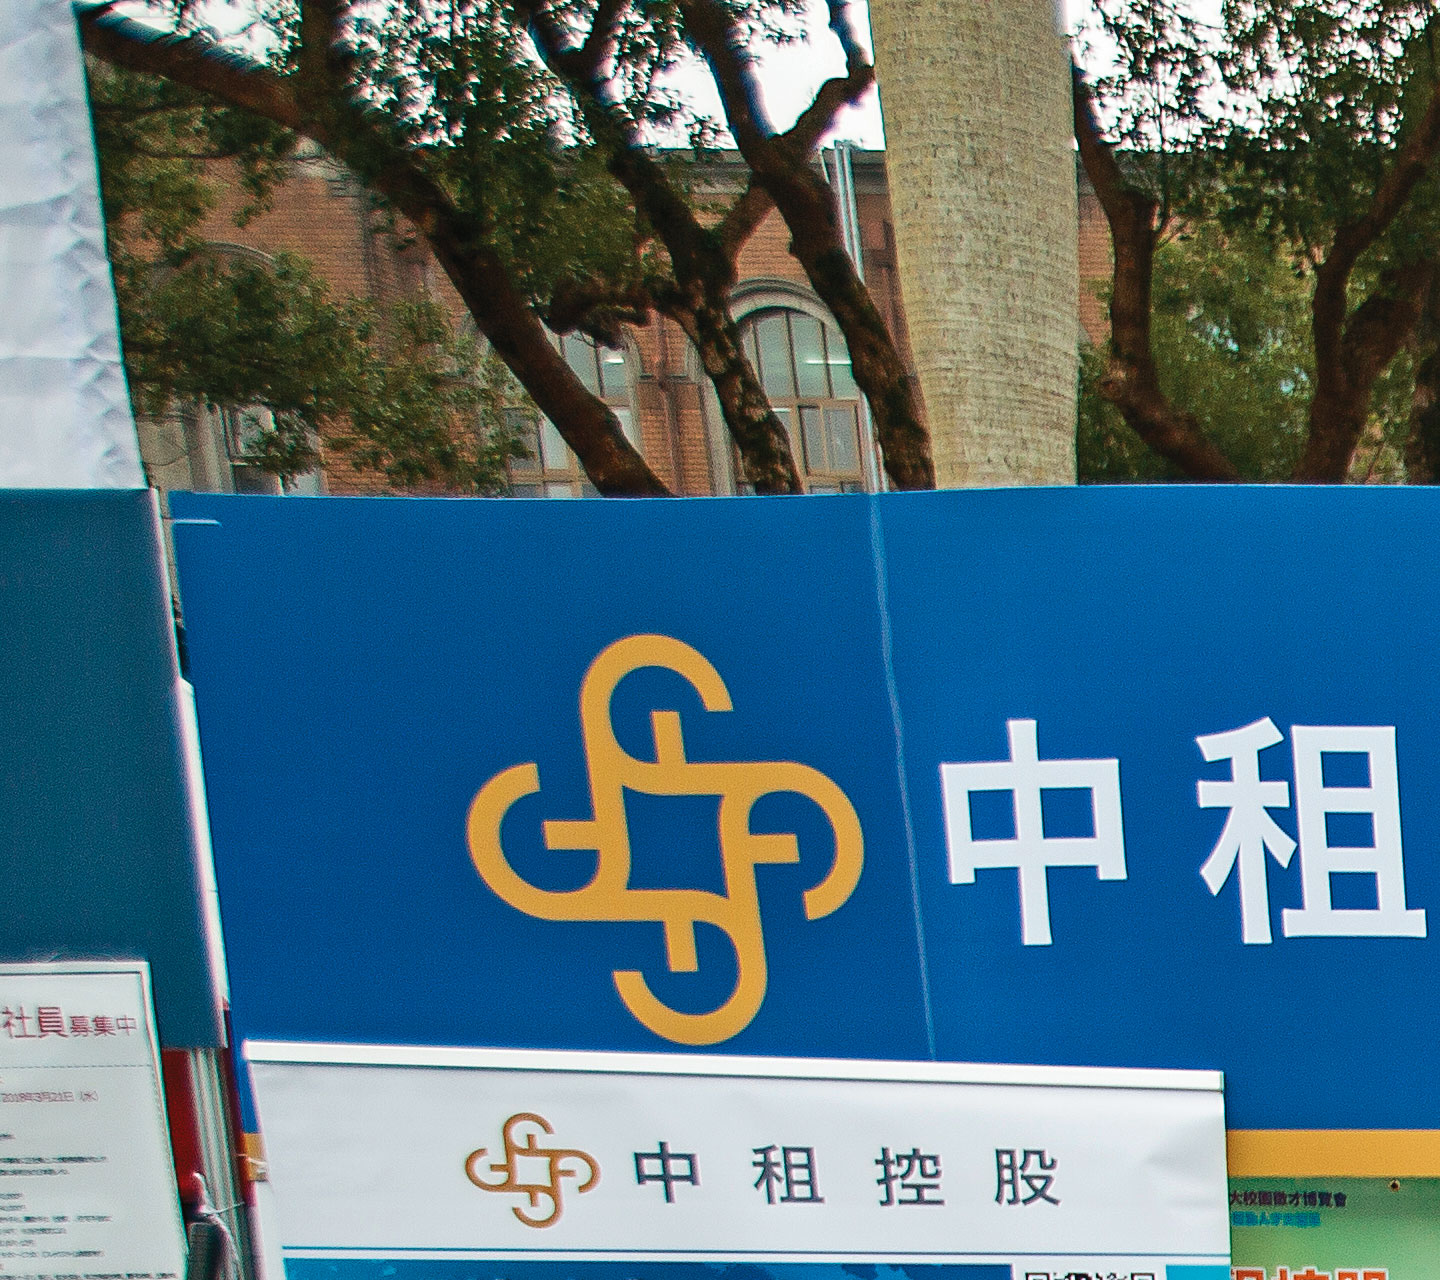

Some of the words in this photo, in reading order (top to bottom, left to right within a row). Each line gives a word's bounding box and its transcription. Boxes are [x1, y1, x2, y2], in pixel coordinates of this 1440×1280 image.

[2, 1005, 137, 1038] 社員募集中
[634, 1141, 1061, 1207] 中租控股
